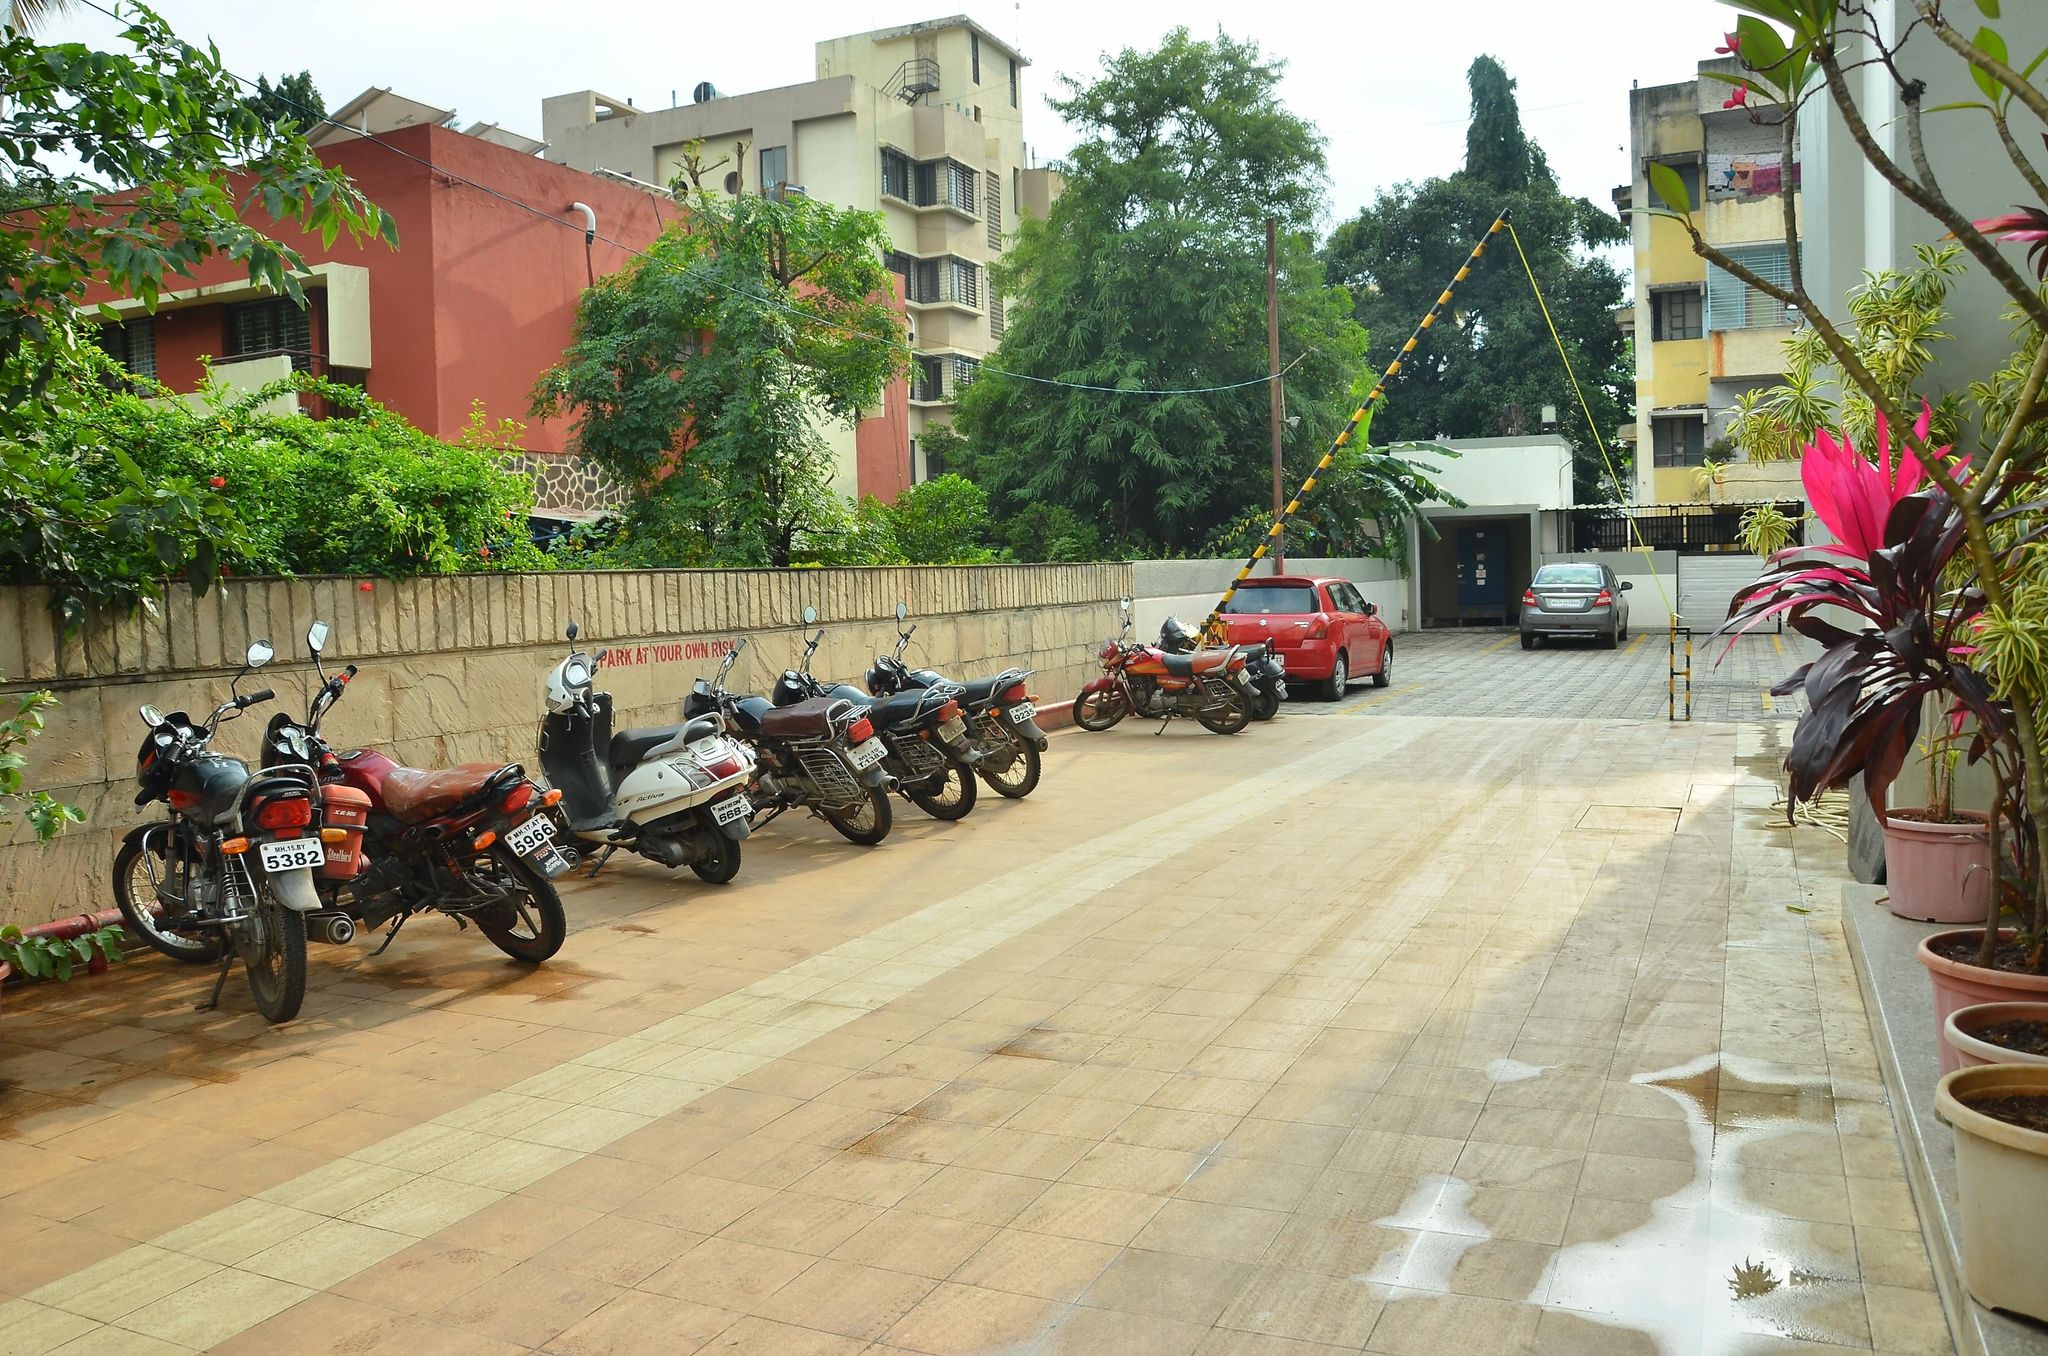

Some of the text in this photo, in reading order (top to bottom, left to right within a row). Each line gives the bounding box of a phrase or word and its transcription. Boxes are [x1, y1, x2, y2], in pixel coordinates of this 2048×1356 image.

[600, 648, 632, 668] PARK
[636, 647, 649, 664] AT
[653, 644, 683, 663] YOUR
[685, 642, 708, 659] OWN
[1014, 708, 1035, 721] 9235
[636, 793, 665, 802] Activa
[719, 804, 748, 822] 6683
[513, 819, 540, 838] MH.17.AT
[513, 823, 553, 854] 5966
[267, 850, 321, 869] 5382
